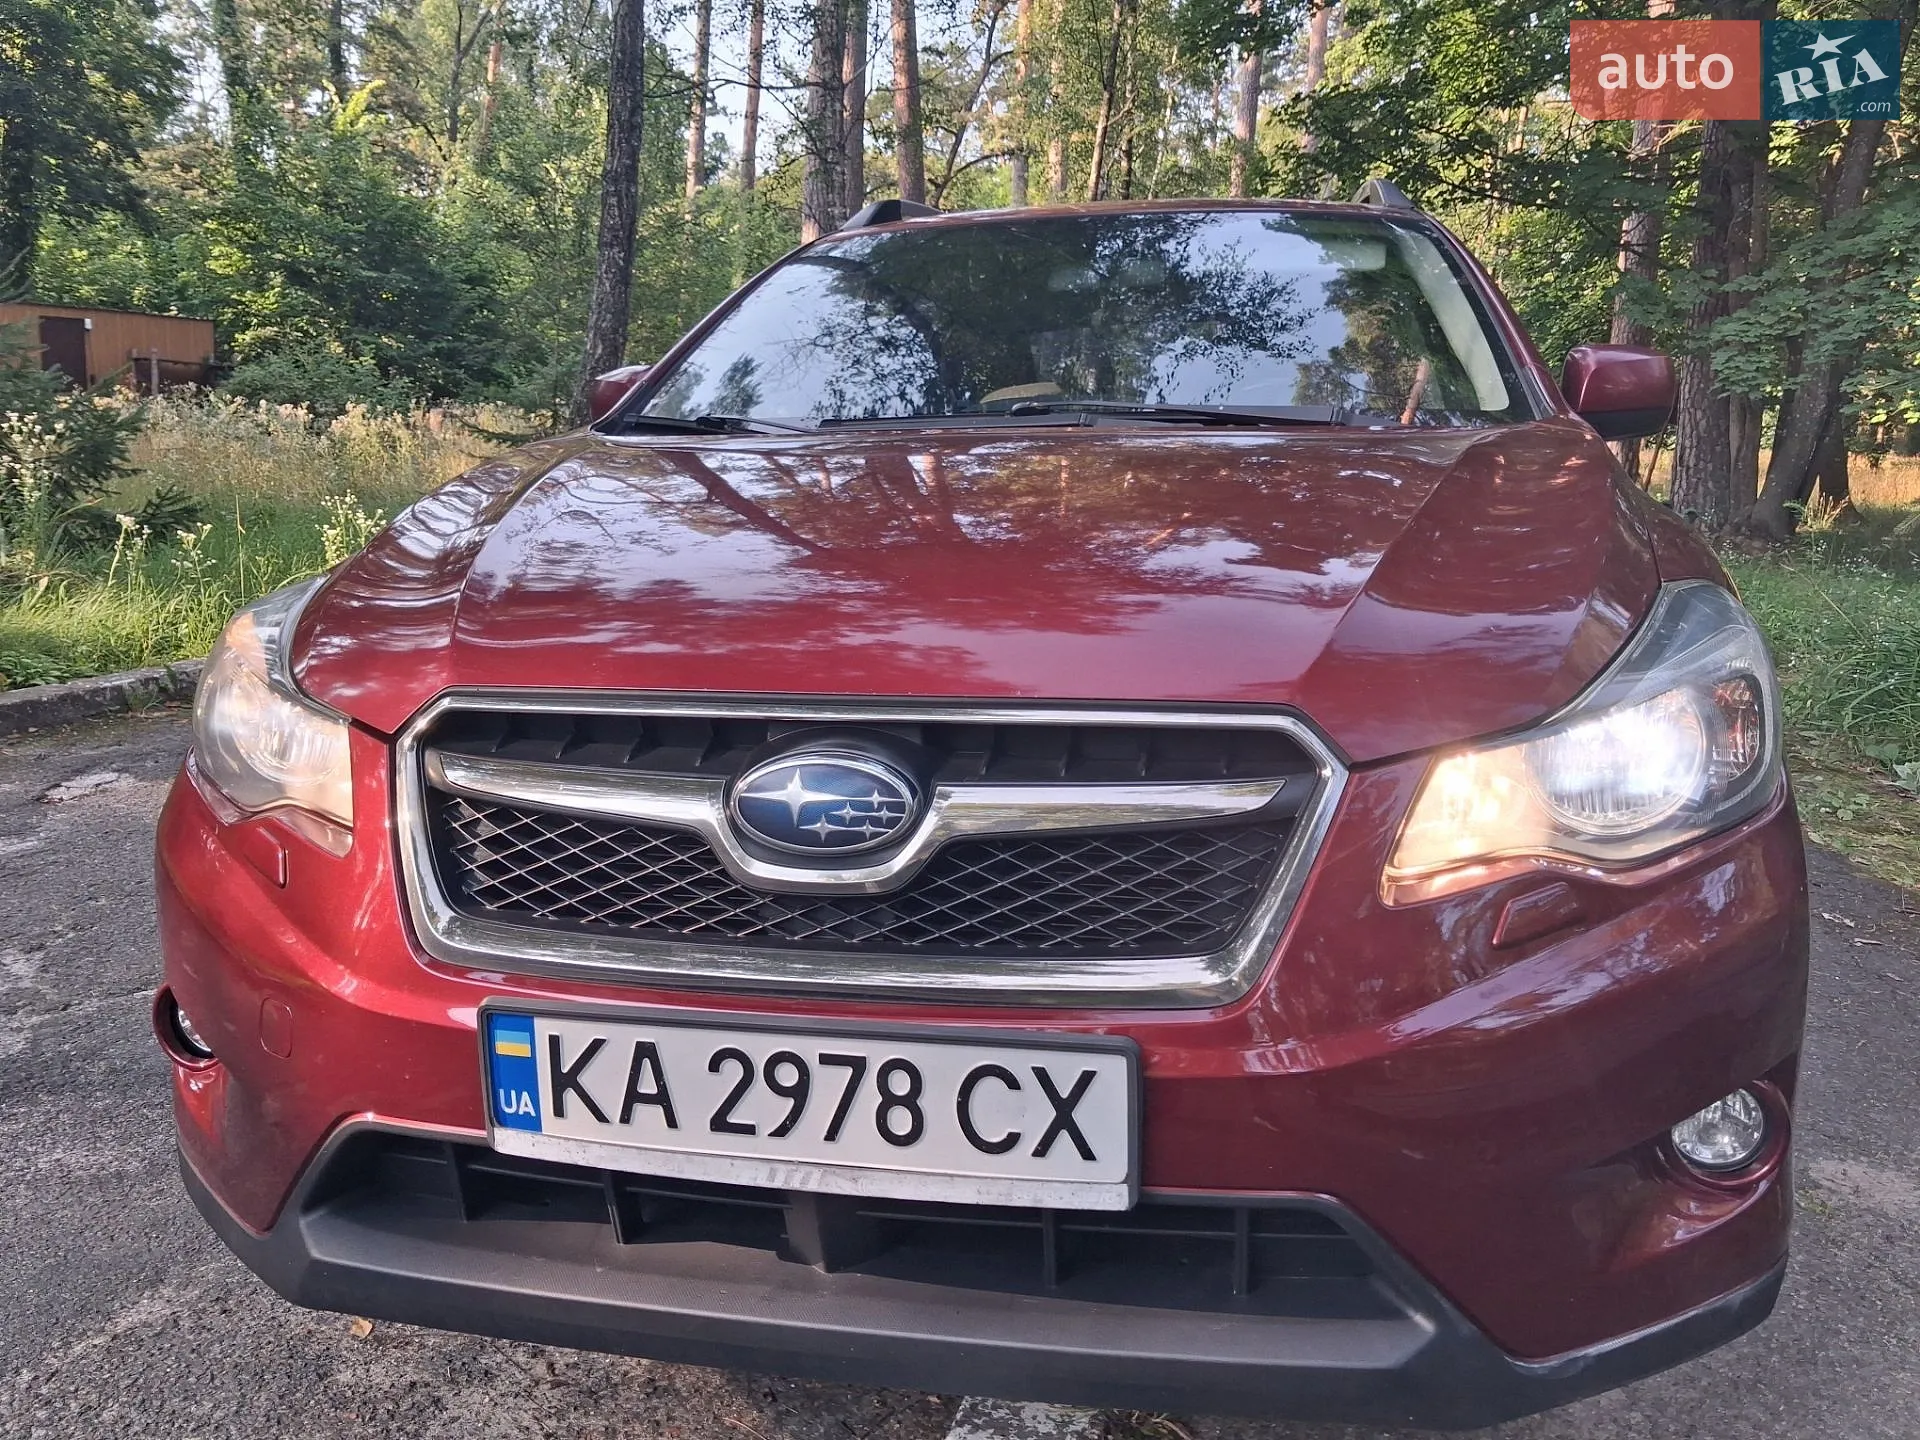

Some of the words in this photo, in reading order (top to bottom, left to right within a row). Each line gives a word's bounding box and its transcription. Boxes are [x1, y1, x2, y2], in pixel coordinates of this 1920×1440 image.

[500, 1088, 536, 1117] UA
[548, 1034, 679, 1129] KA
[706, 1047, 925, 1147] 2978
[956, 1064, 1098, 1161] CX
